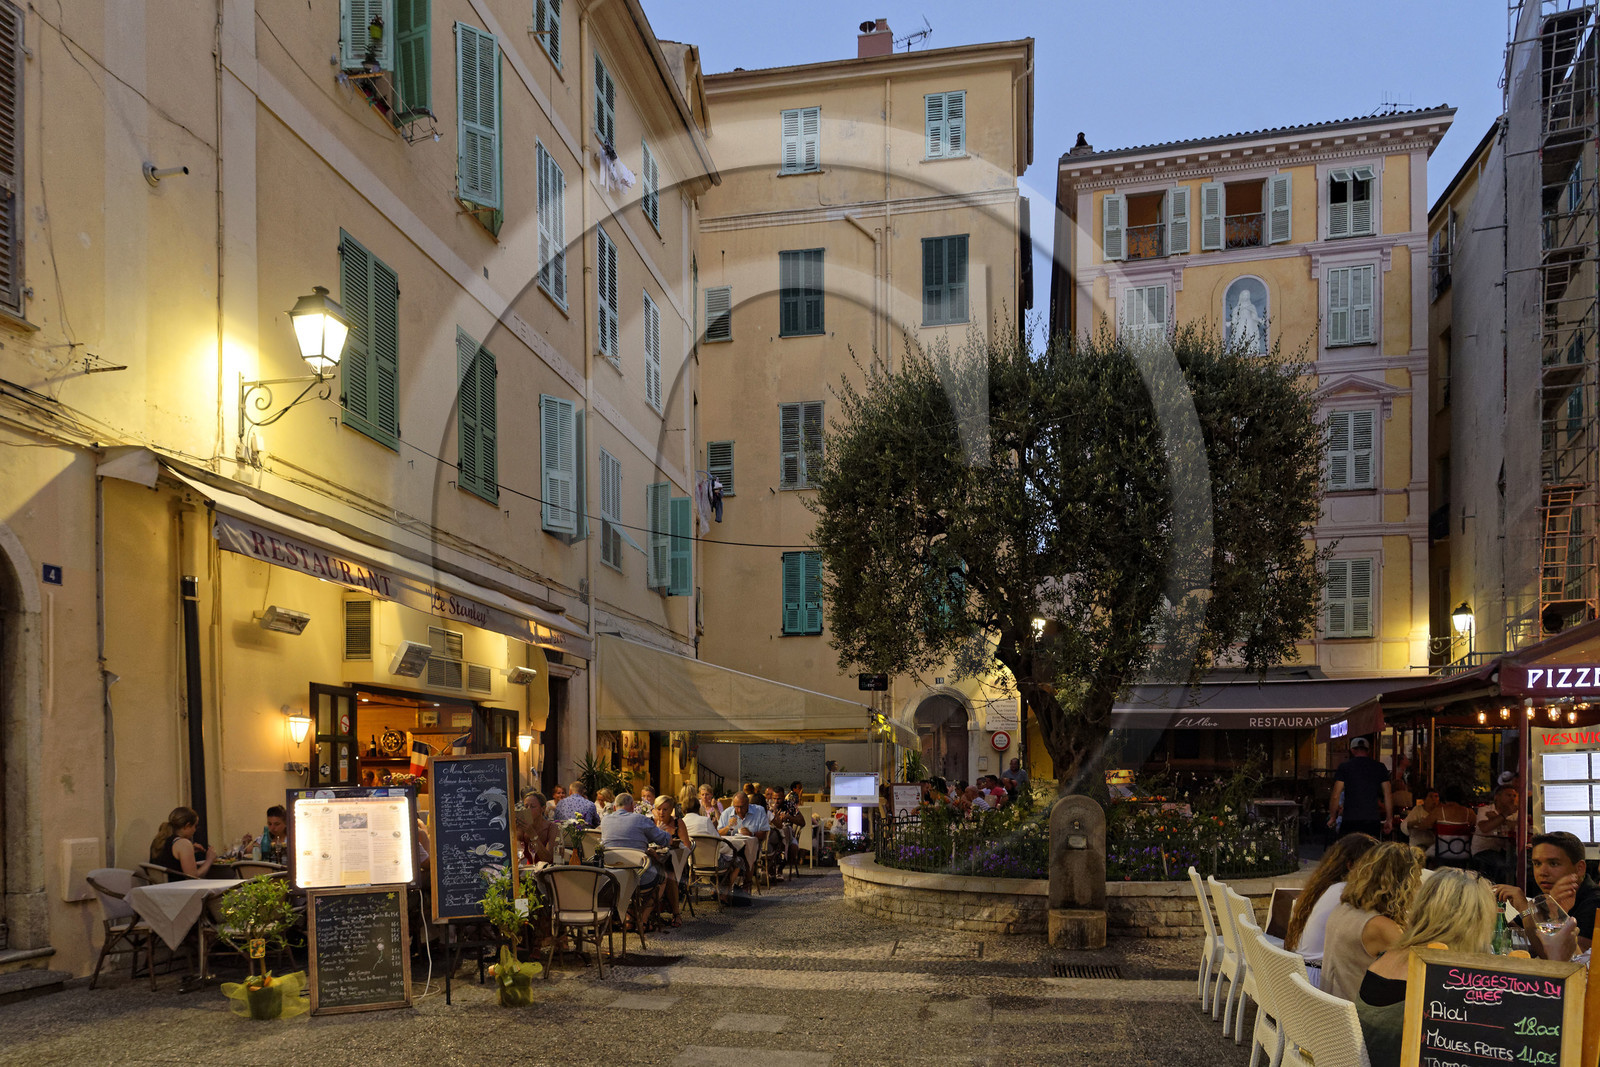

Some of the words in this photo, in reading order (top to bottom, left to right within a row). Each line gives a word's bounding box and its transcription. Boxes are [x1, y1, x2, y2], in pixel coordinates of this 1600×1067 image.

[249, 529, 391, 597] RESTAURANT
[49, 569, 56, 581] 4
[1249, 716, 1331, 728] RESTAURAN
[1446, 968, 1540, 993] SUGGESTION
[1543, 980, 1562, 998] DU
[1465, 989, 1504, 1002] CHEF
[1474, 1040, 1514, 1061] FRITES
